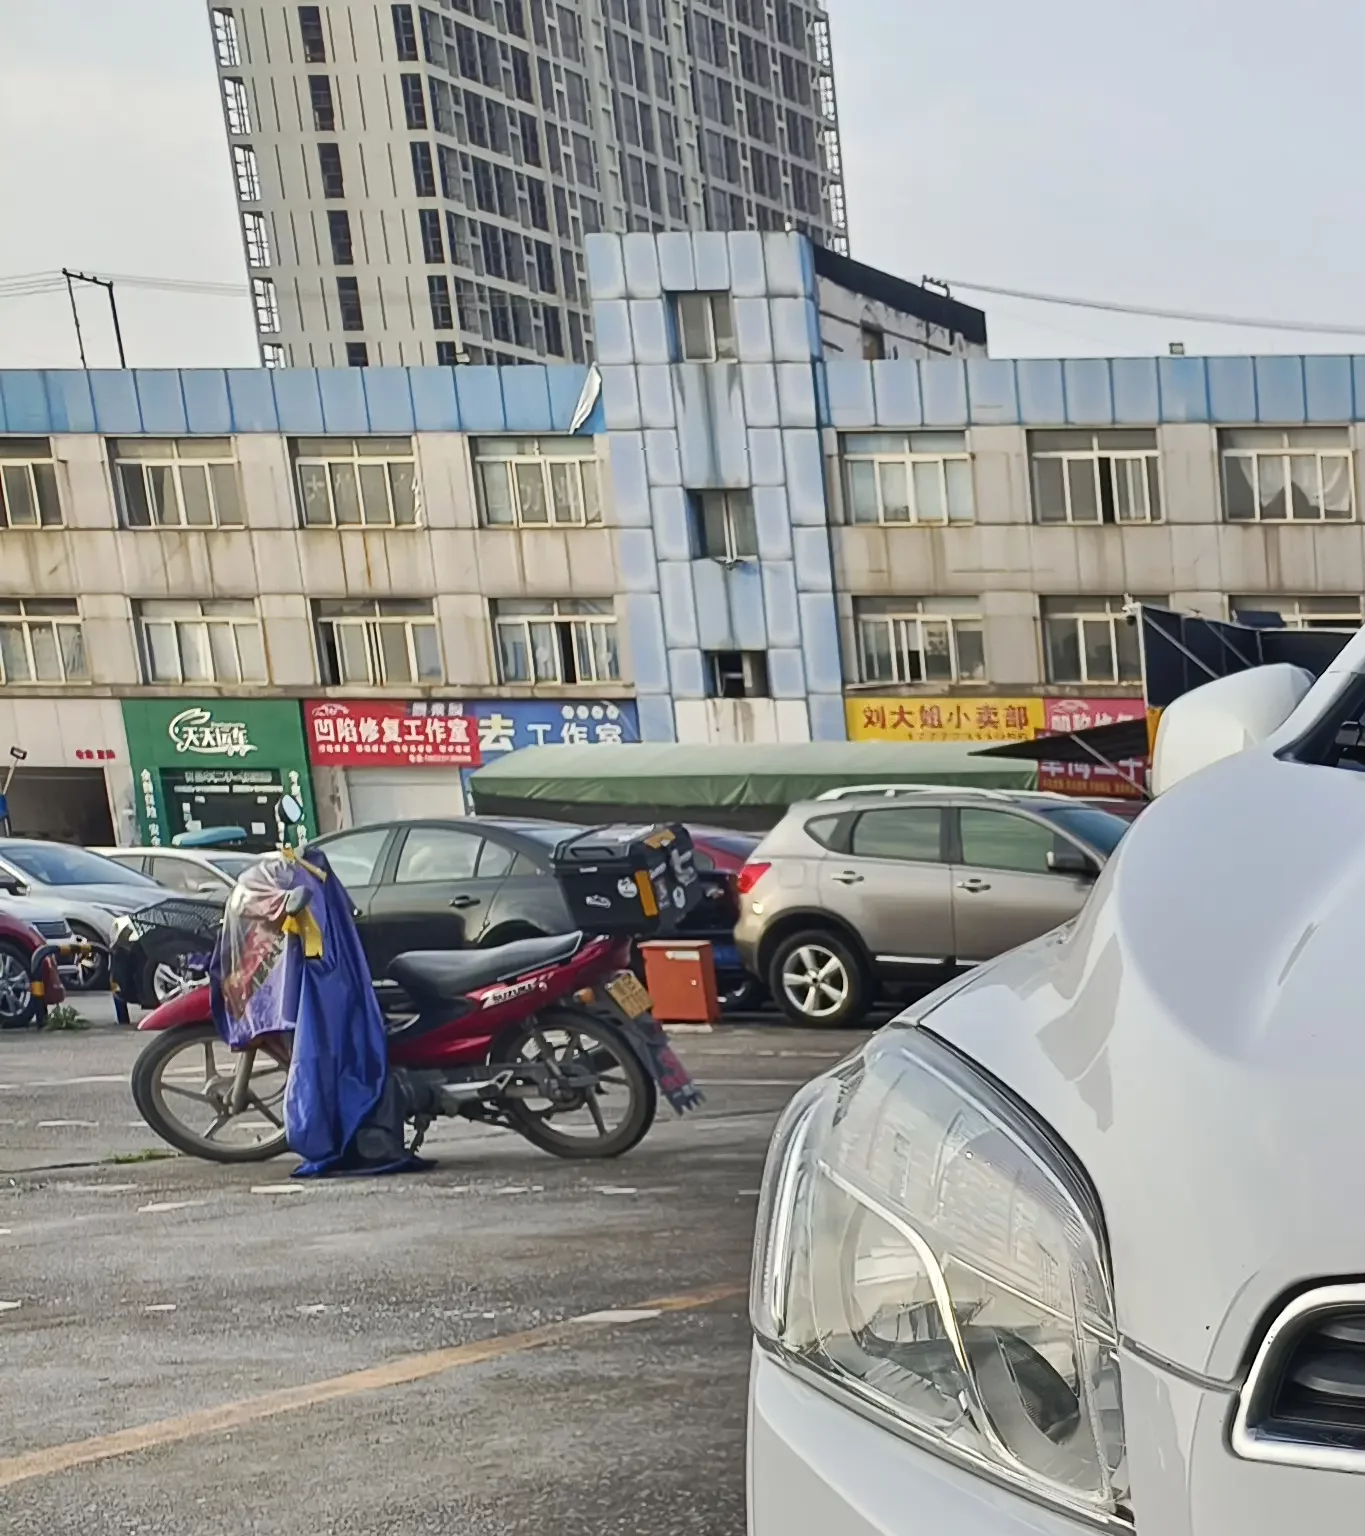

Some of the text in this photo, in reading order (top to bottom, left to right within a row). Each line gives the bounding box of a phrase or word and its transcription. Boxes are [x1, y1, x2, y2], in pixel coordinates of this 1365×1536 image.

[313, 716, 470, 743] 凹陷修复工作室
[862, 704, 1029, 731] 刘大姐小卖部
